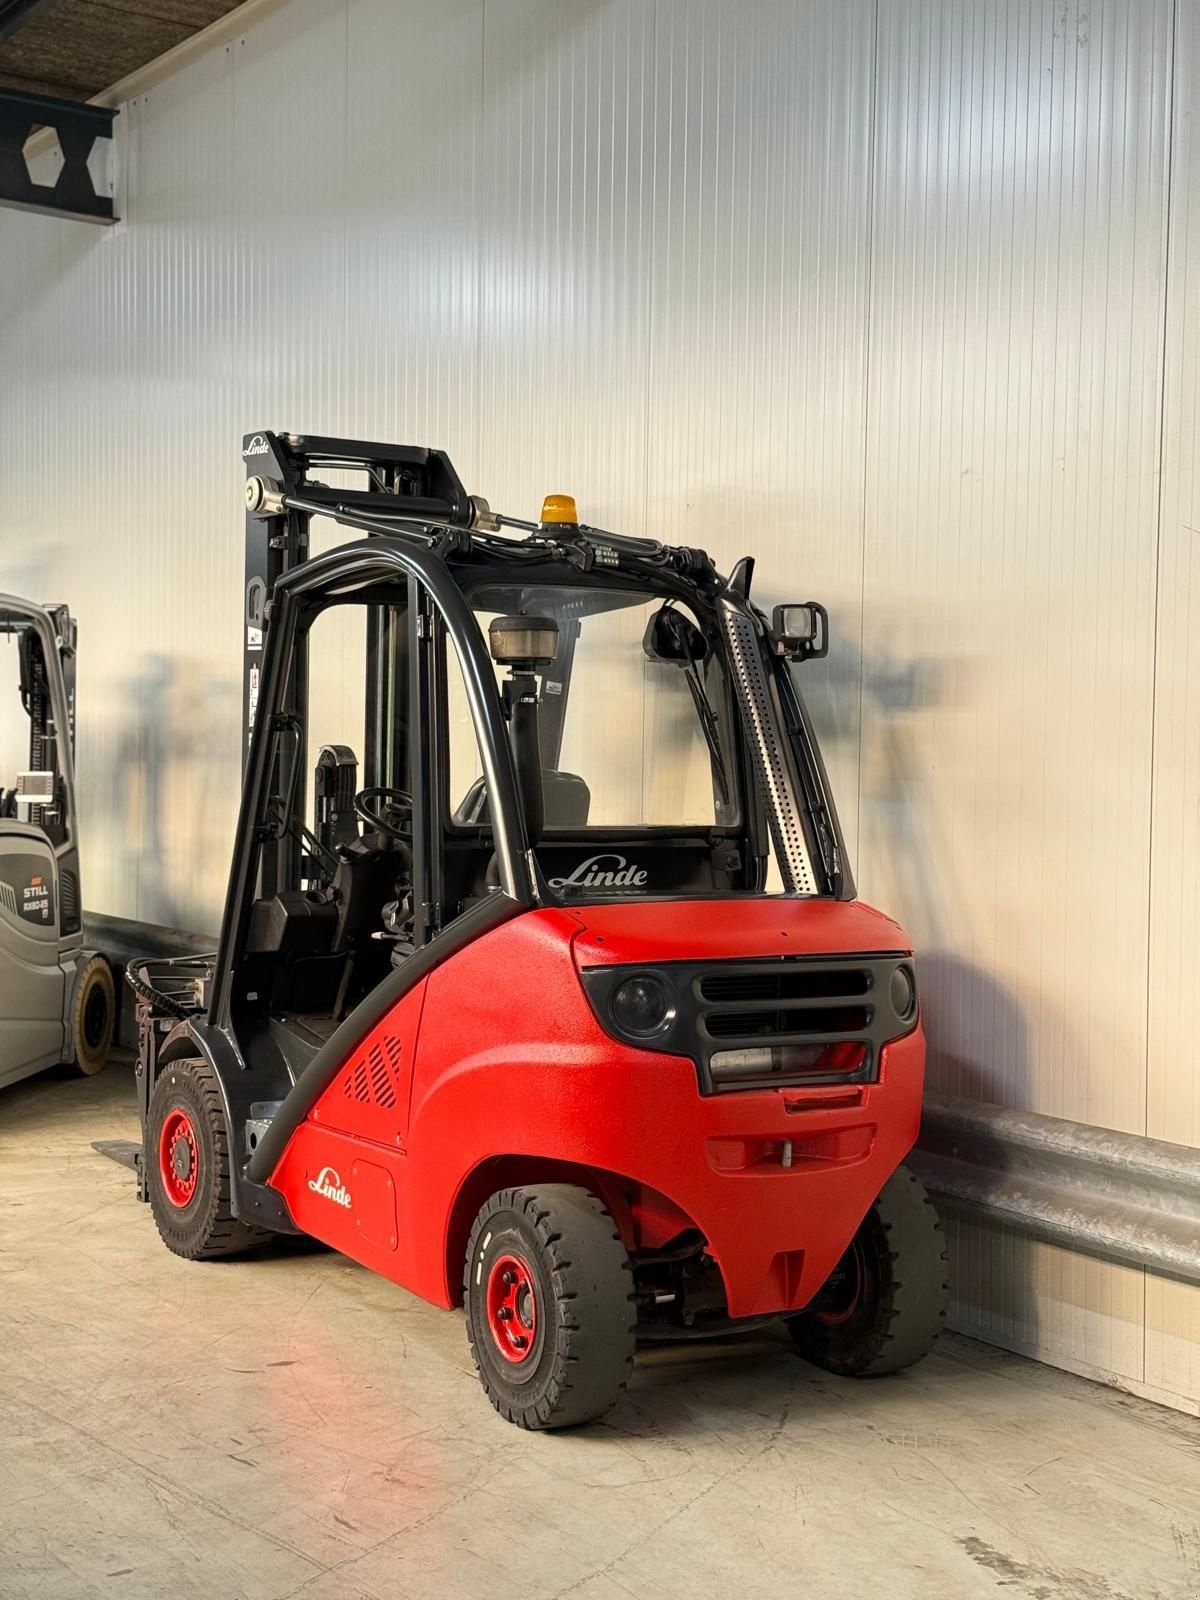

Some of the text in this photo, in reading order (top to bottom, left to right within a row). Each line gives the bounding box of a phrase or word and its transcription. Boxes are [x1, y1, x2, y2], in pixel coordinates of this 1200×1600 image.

[242, 435, 269, 457] Linde
[548, 854, 648, 888] Linde
[23, 885, 49, 898] STILL
[308, 1166, 352, 1209] Linde
